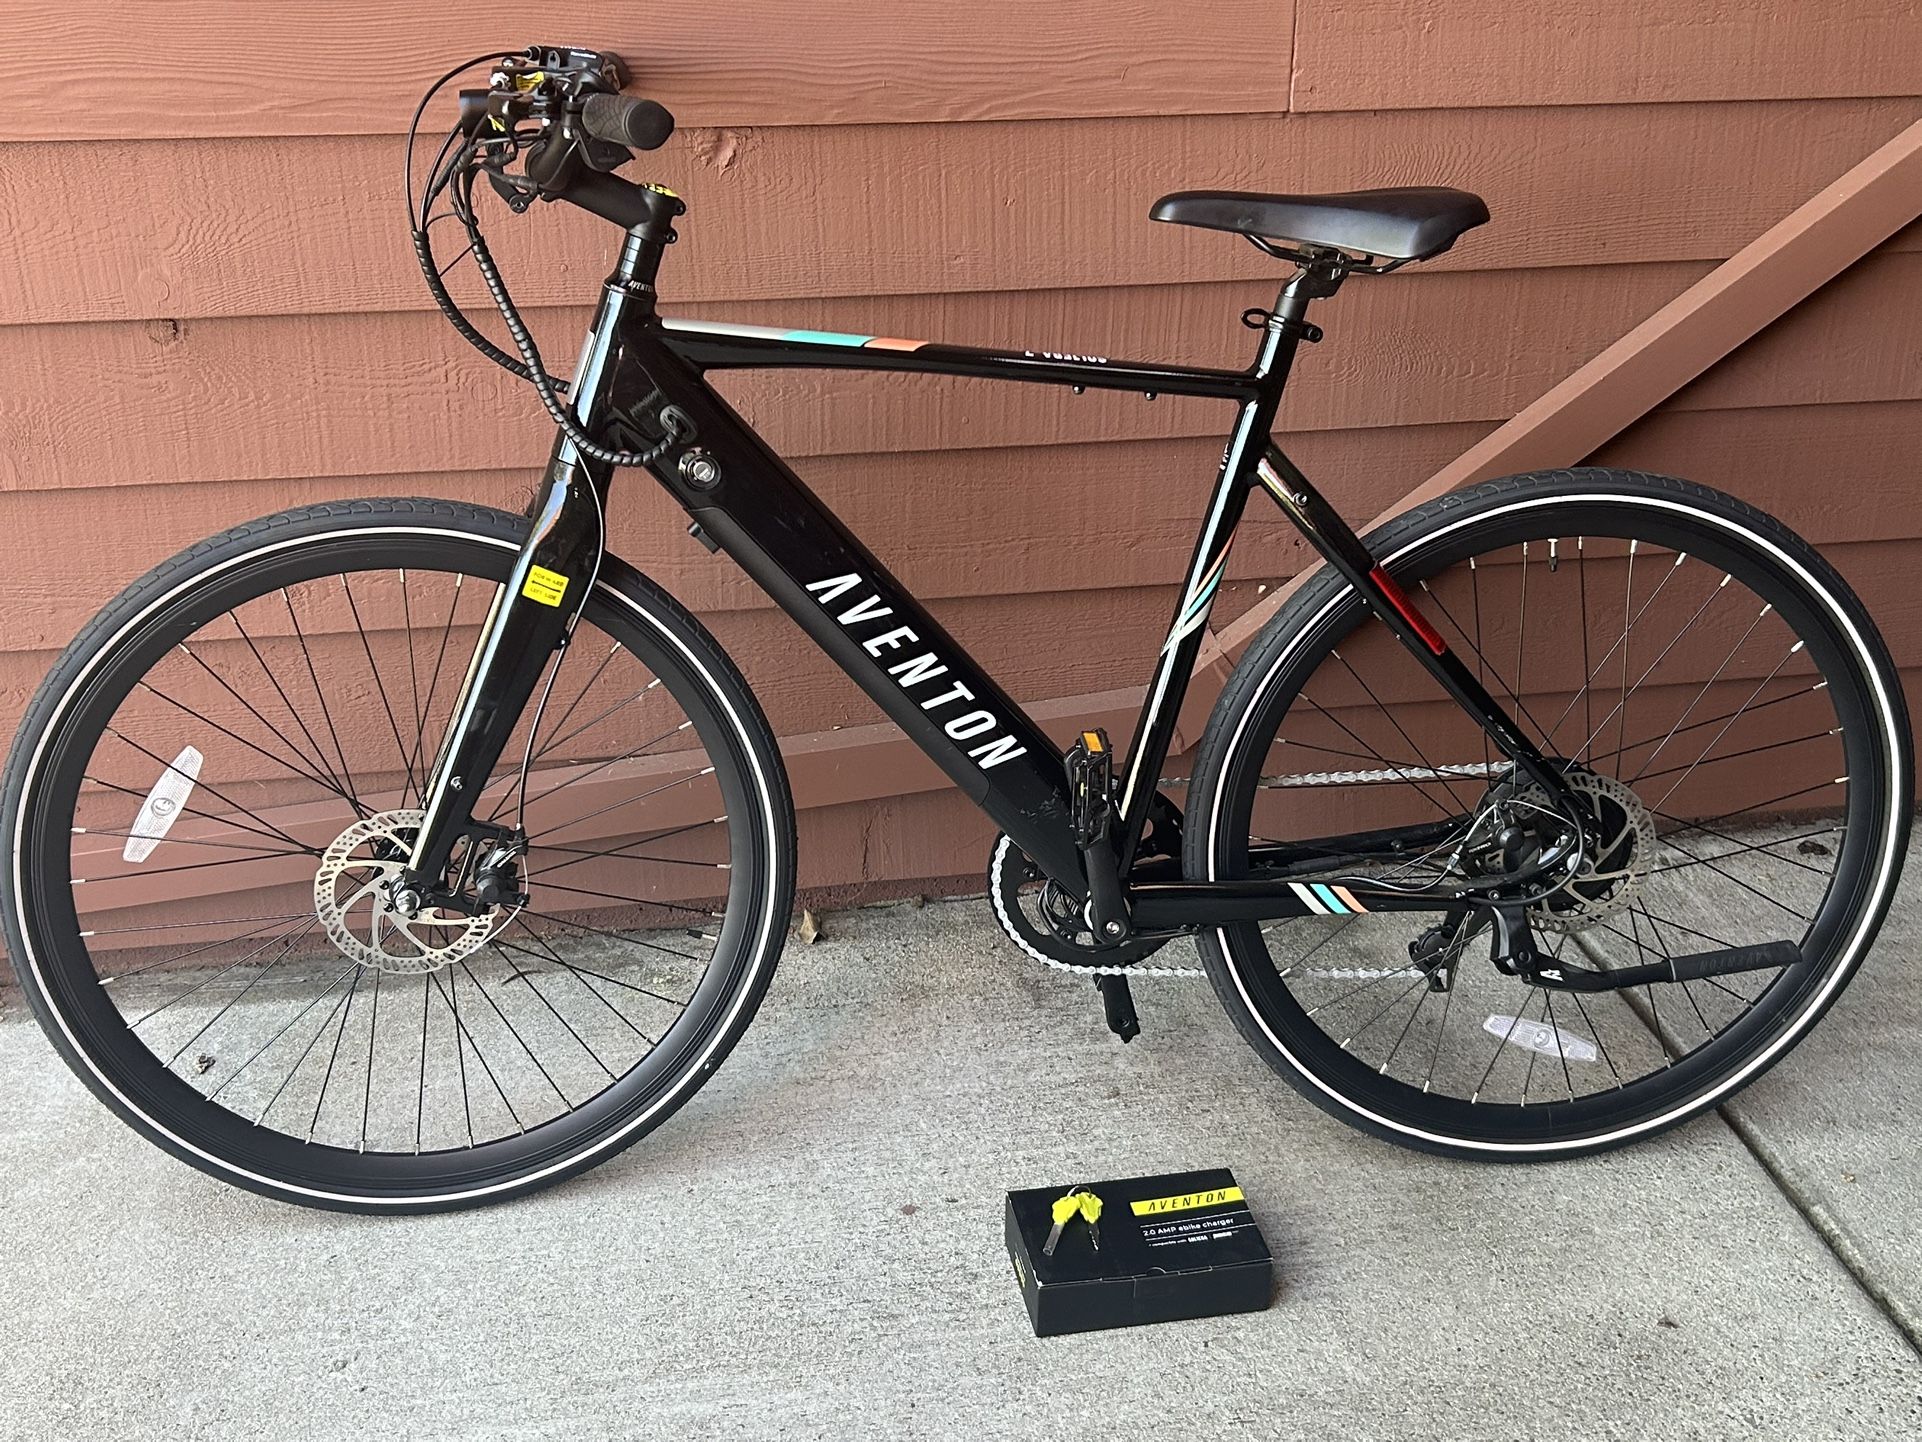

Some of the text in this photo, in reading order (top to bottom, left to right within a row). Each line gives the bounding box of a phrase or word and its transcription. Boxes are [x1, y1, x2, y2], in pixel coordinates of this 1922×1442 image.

[806, 572, 1028, 770] AVENTON
[1148, 1190, 1226, 1212] AVENTON
[1143, 1217, 1234, 1237] 2.0 AMP ebike charger
